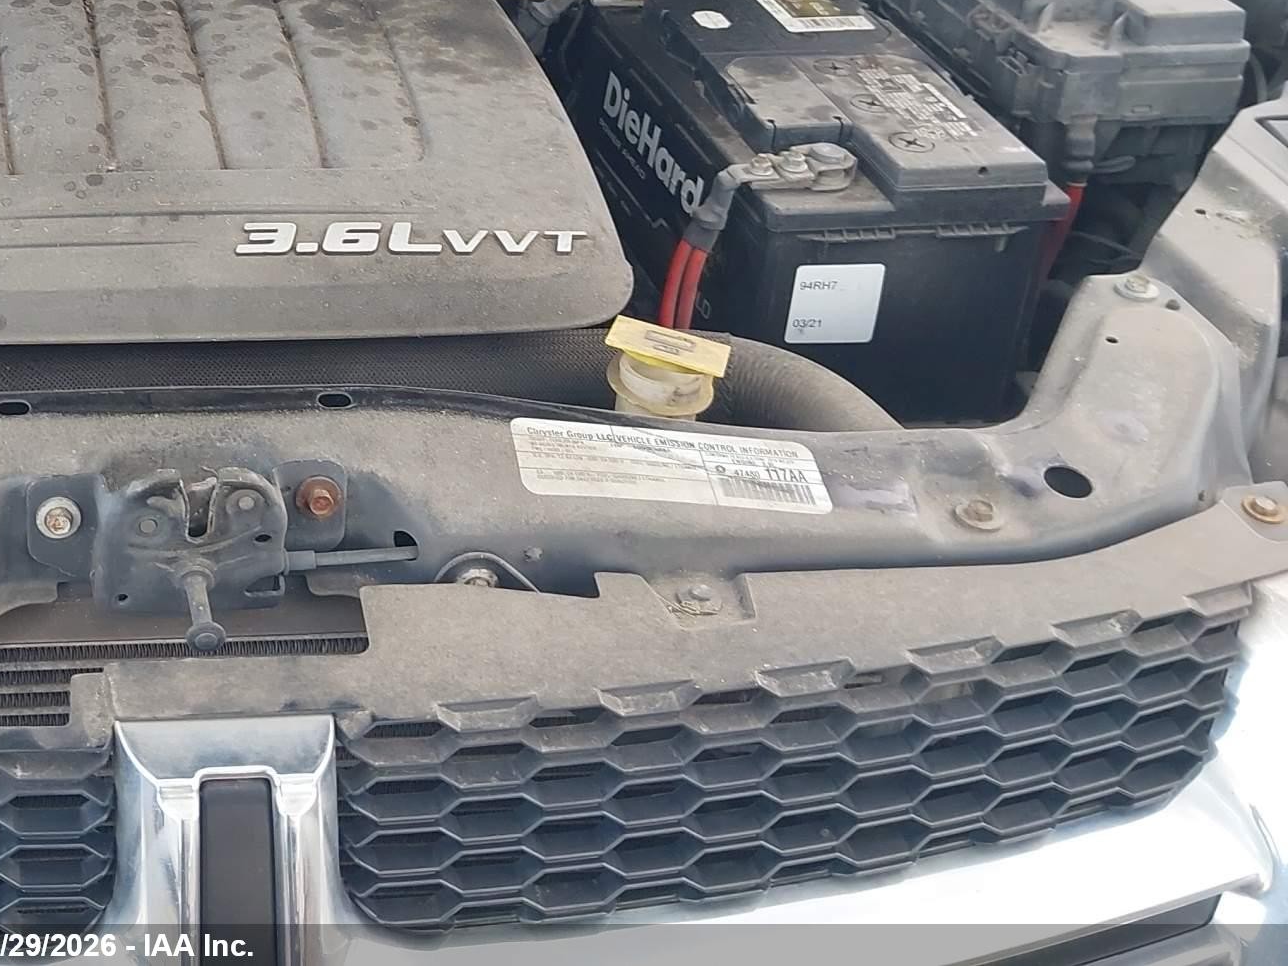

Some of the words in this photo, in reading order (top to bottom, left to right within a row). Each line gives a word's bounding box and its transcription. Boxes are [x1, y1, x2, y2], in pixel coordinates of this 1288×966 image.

[603, 71, 705, 216] DieHard
[235, 221, 443, 255] 3.6L
[443, 229, 588, 255] VVT
[799, 280, 838, 291] 94RH7
[791, 318, 823, 329] 03/21
[526, 426, 564, 438] Chrysler
[566, 429, 593, 441] Group
[596, 433, 613, 442] LLC
[615, 434, 651, 445] VEHICLE
[654, 438, 695, 449] EMISSION
[697, 442, 736, 453] CONTROL
[739, 446, 799, 458] INFORMATION
